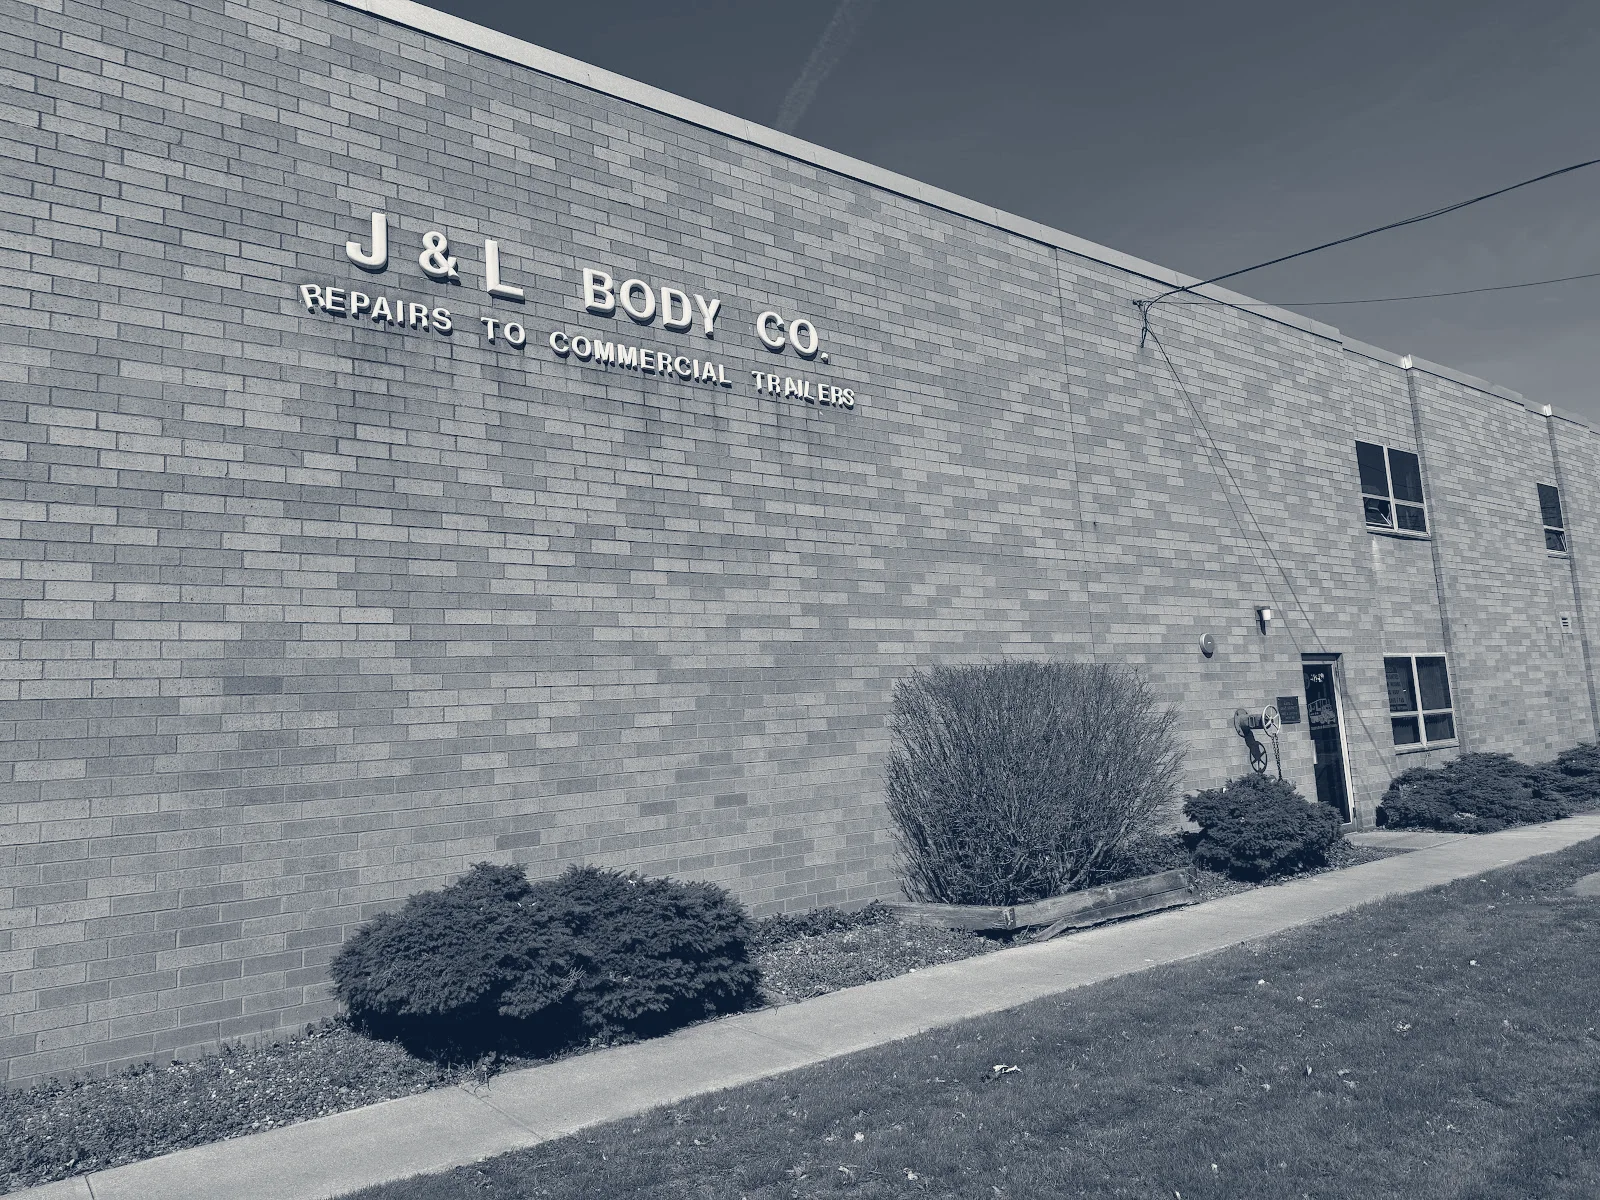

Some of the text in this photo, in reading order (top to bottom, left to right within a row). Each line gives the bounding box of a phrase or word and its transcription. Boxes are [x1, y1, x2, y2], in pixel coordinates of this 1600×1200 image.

[300, 283, 856, 408] REPAIRS TO COMMERCIAL TRAILERS
[345, 211, 829, 362] J & L BODY CO.
